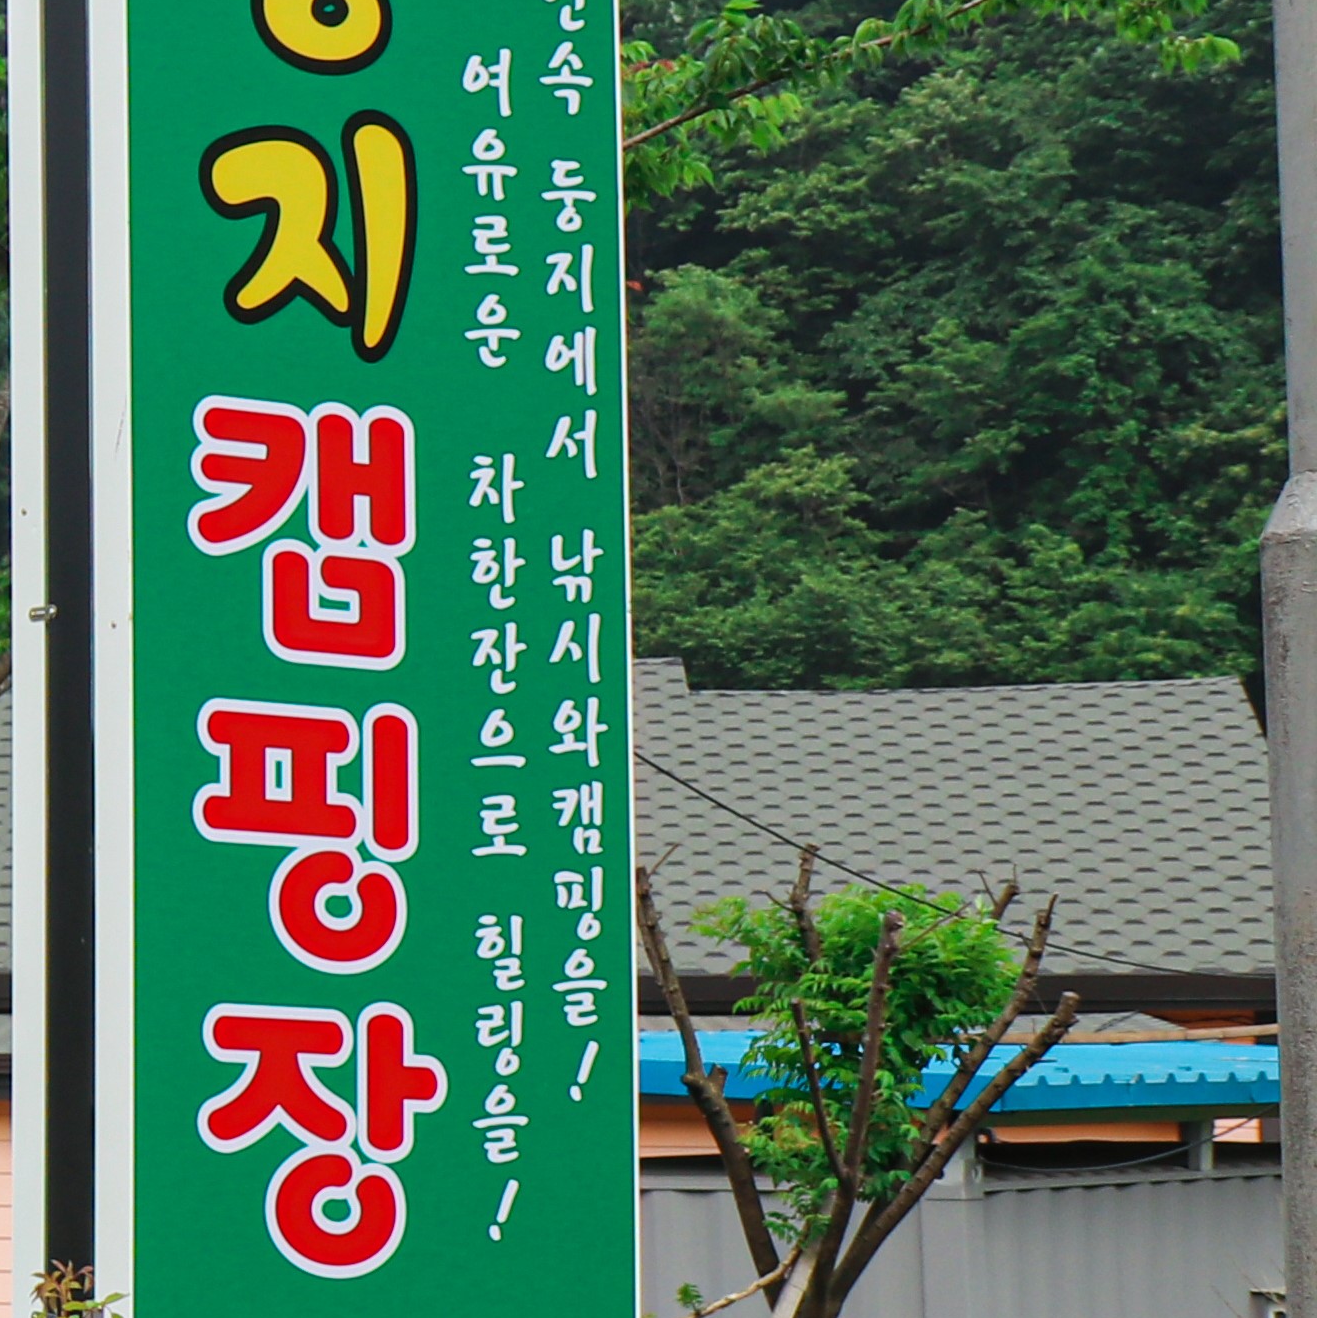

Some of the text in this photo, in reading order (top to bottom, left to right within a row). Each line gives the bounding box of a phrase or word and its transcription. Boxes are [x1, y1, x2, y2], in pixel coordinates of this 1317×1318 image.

[542, 160, 597, 480] 둥지에서
[462, 48, 529, 1241] 여유로운 차한잔으로 힐링을!
[549, 528, 608, 1101] 낚시와캠핑을!
